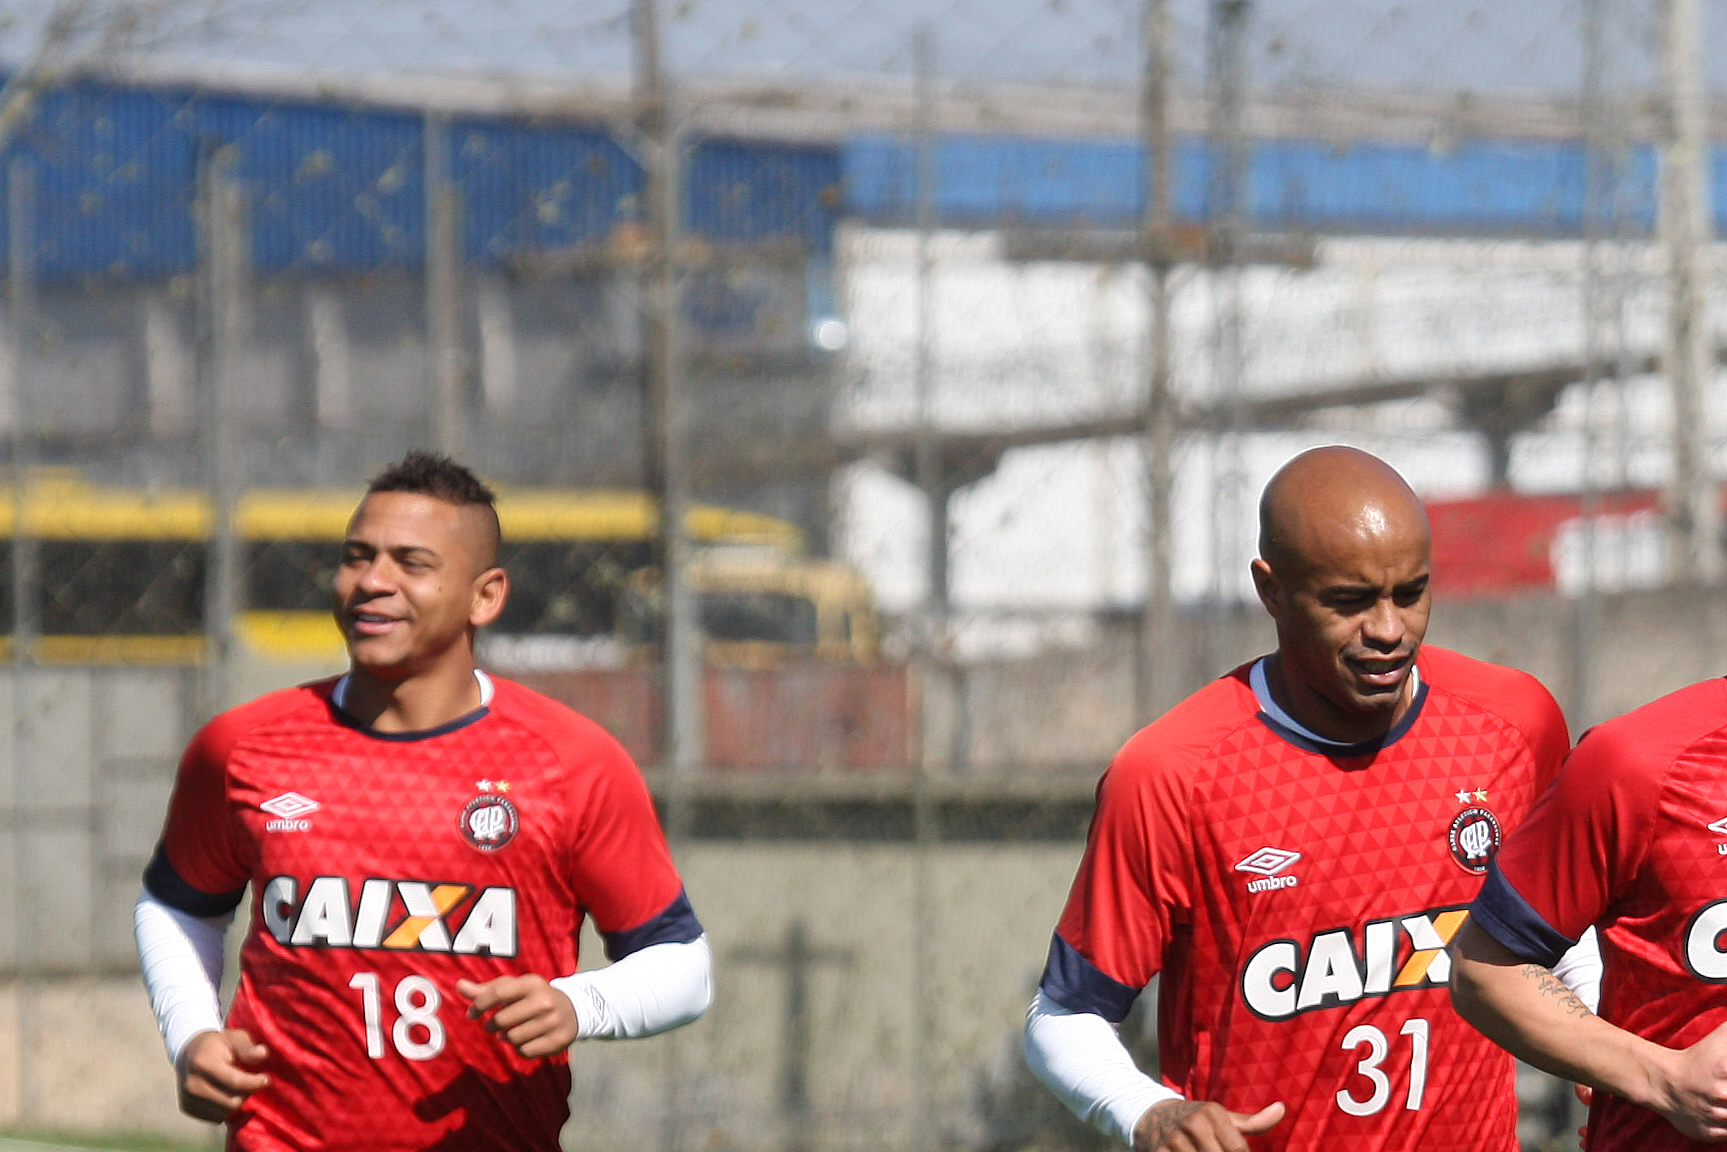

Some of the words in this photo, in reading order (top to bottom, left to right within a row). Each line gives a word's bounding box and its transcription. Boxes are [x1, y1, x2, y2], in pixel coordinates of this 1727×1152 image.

[265, 818, 311, 832] umbro
[262, 875, 517, 957] CAIXA
[1247, 874, 1298, 893] umbro
[1241, 908, 1470, 1018] CAIX
[349, 971, 446, 1061] 18
[1336, 1018, 1429, 1116] 31
